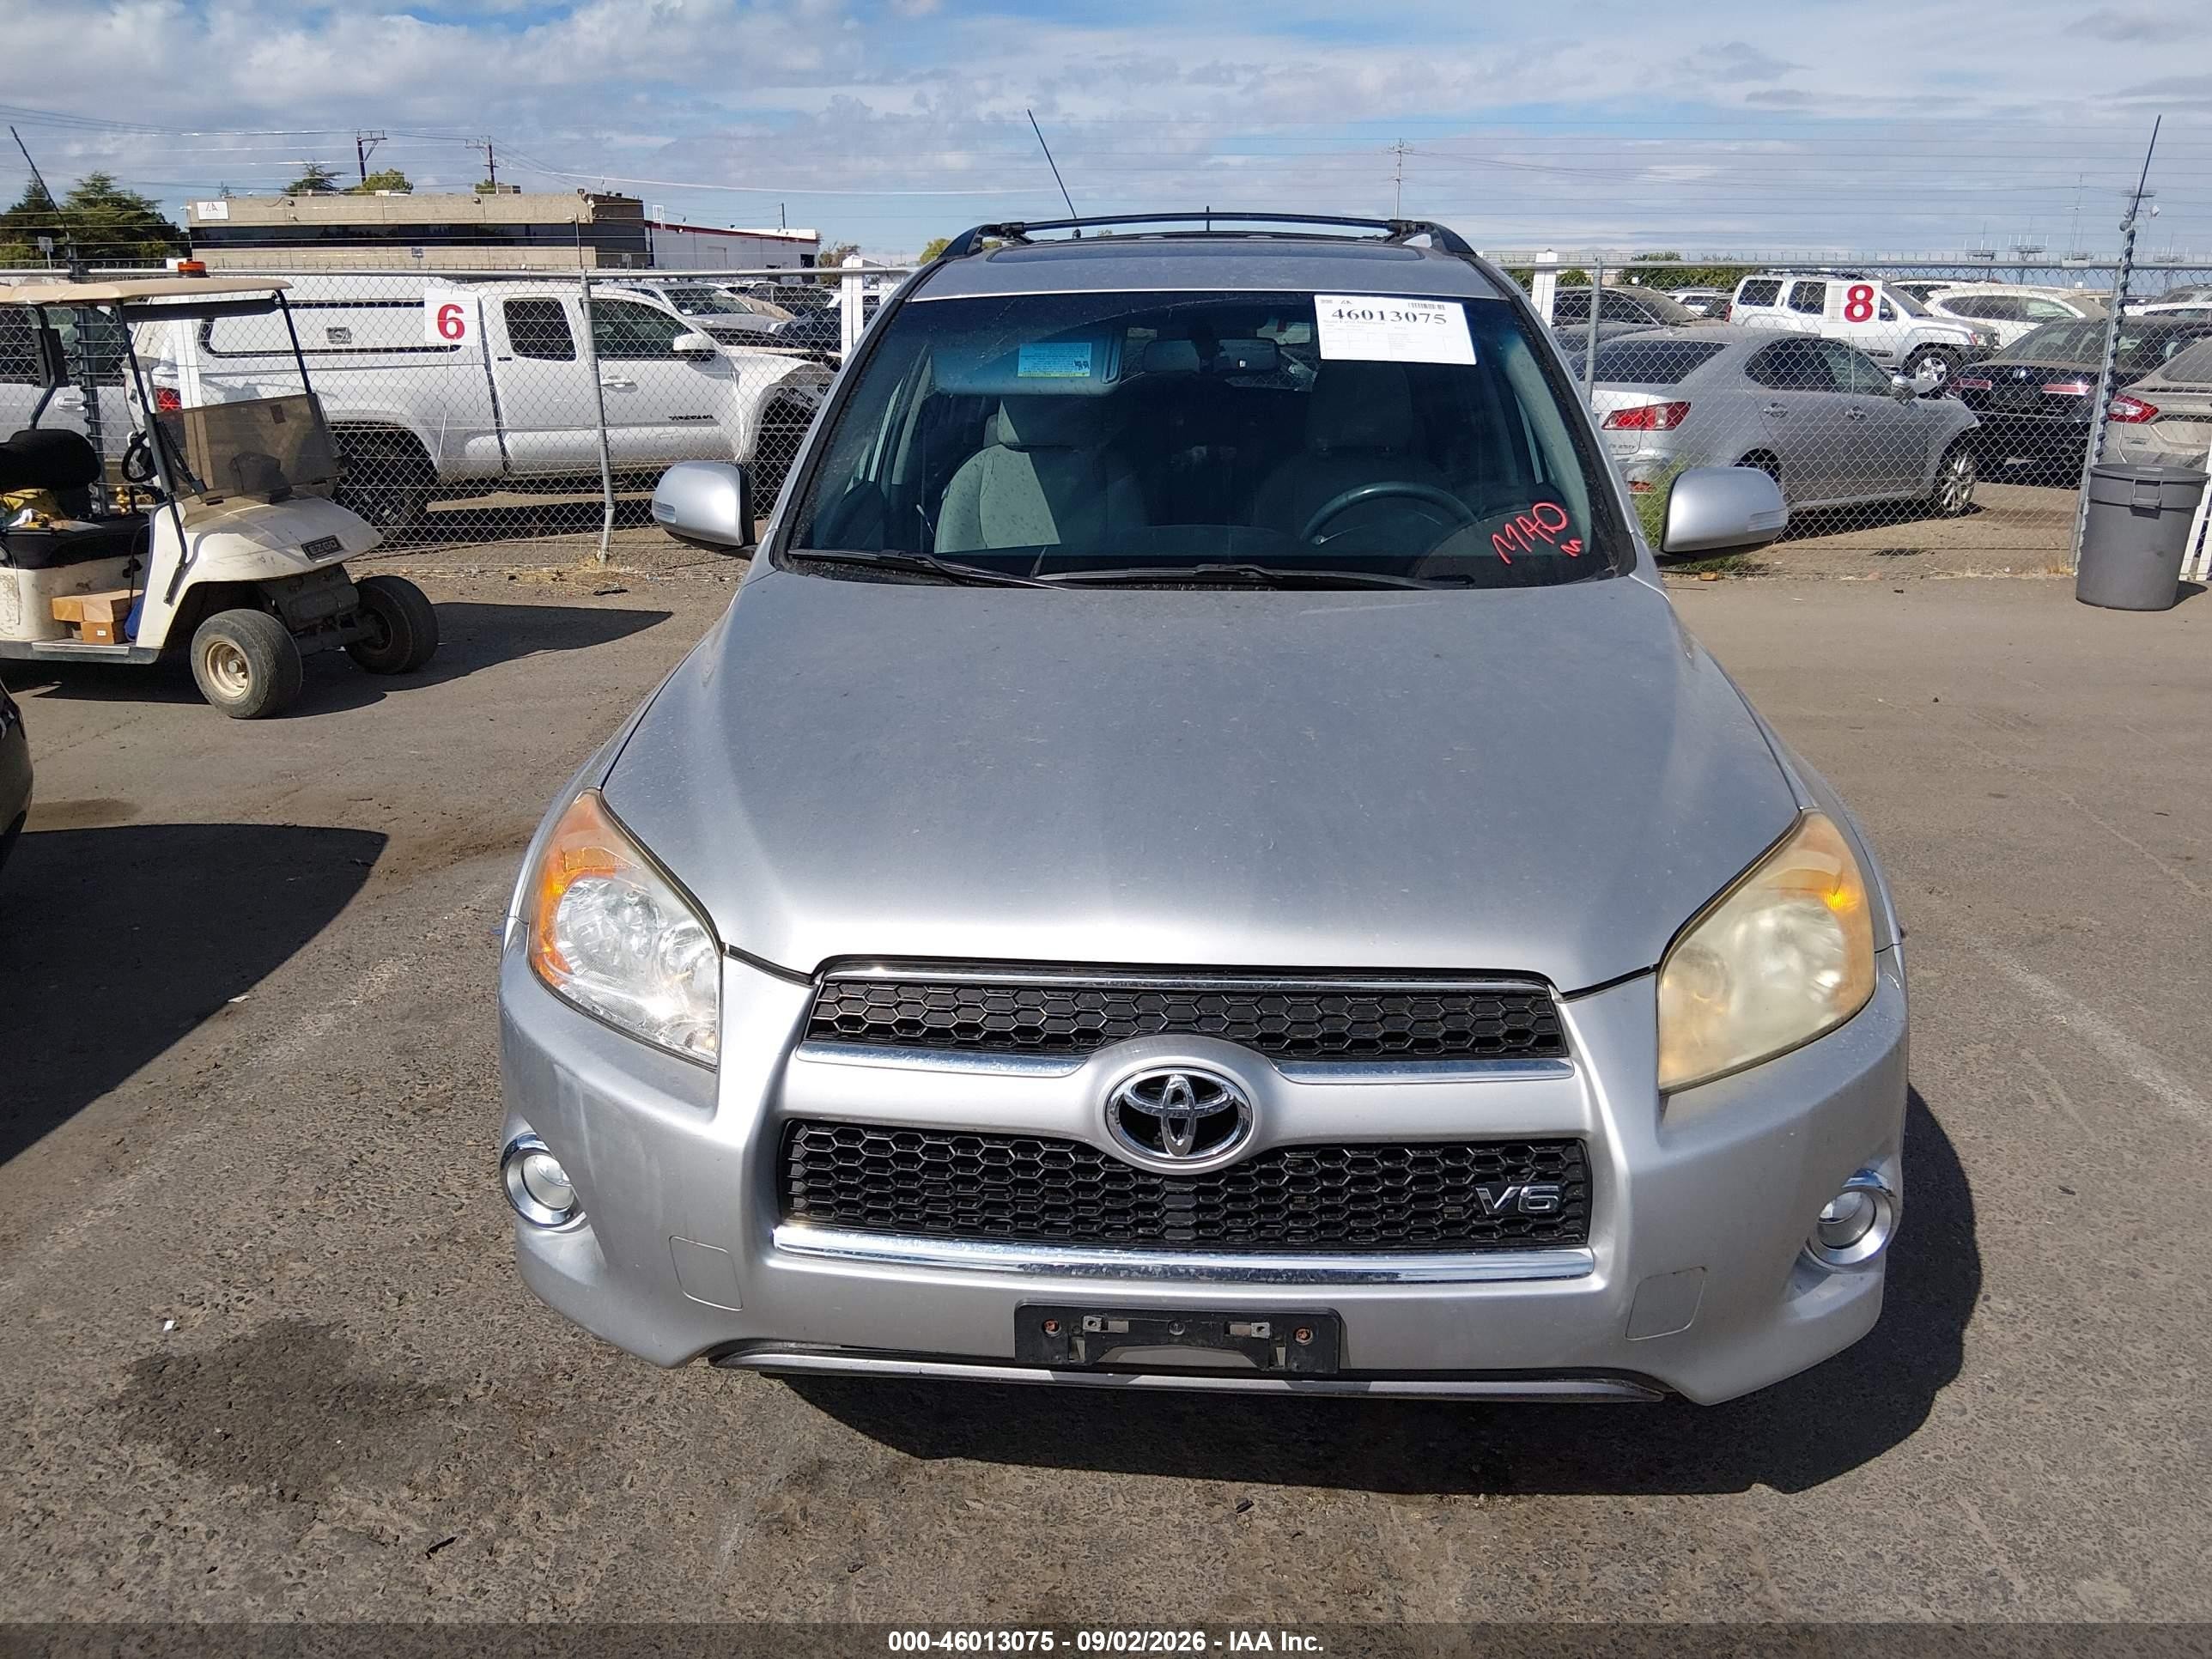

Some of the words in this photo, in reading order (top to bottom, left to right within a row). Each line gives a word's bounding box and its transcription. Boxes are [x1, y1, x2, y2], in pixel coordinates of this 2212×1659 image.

[1332, 308, 1448, 325] 46013075
[1844, 284, 1875, 323] 8
[437, 304, 465, 340] 6
[1475, 1185, 1559, 1215] V6
